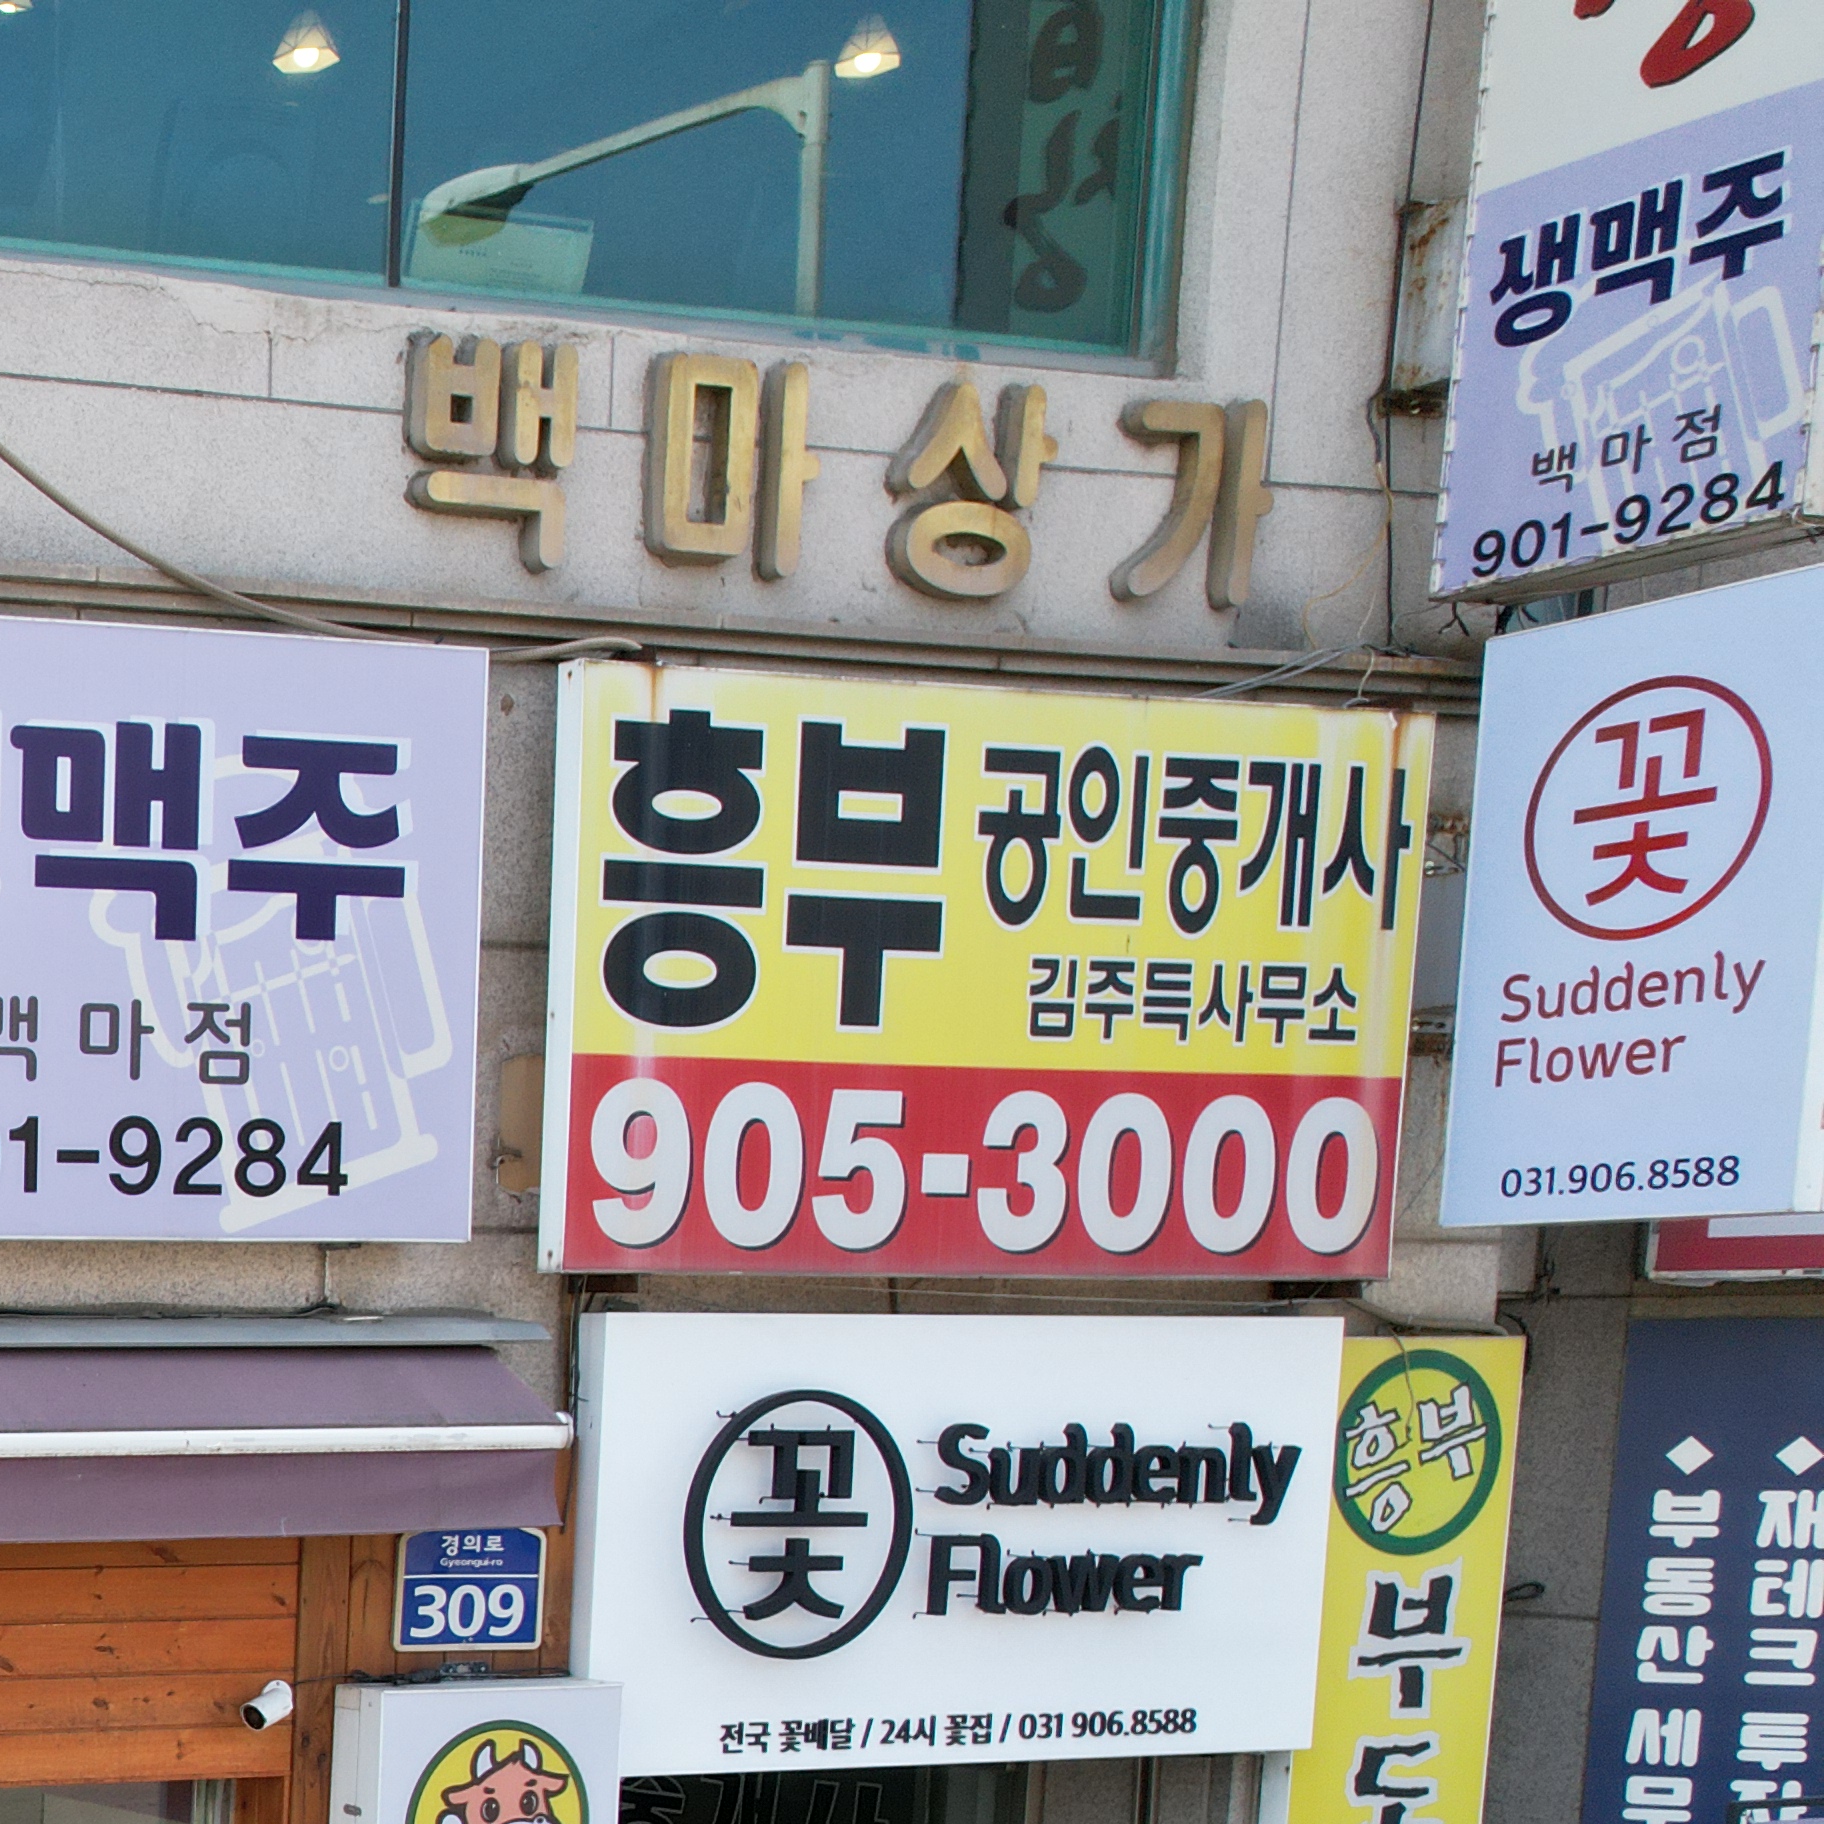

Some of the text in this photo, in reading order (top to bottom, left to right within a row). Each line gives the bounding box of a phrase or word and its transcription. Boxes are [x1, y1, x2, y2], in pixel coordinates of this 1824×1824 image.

[1490, 151, 1785, 348] 생맥주
[404, 331, 1273, 609] 백마상가
[1472, 460, 1785, 578] 901-9284
[1573, 707, 1719, 909] 꽃
[599, 708, 1412, 1030] 흥부 공인중개사
[1028, 956, 1358, 1046] 김주득사무소
[1500, 952, 1766, 1023] Suddenly
[1495, 1029, 1686, 1088] Flower
[589, 1077, 1383, 1256] 905-3000
[1499, 1152, 1740, 1200] 031.906.8588
[1342, 1384, 1487, 1534] 흥부
[440, 1557, 503, 1567] Gyeongui-ro
[441, 1535, 504, 1556] 경의로
[728, 1422, 1302, 1622] 꽃 Suddenly
[923, 1532, 1203, 1617] Flower
[409, 1583, 525, 1638] 309
[1635, 1490, 1721, 1684] 부동산
[1744, 1490, 1824, 1686] 재테크
[720, 1720, 771, 1755] 전국
[778, 1717, 855, 1753] 꽃배달
[881, 1717, 936, 1747] 24시
[944, 1714, 995, 1747] 꽃집
[1019, 1711, 1063, 1740] 031
[1071, 1708, 1196, 1739] 906.8588
